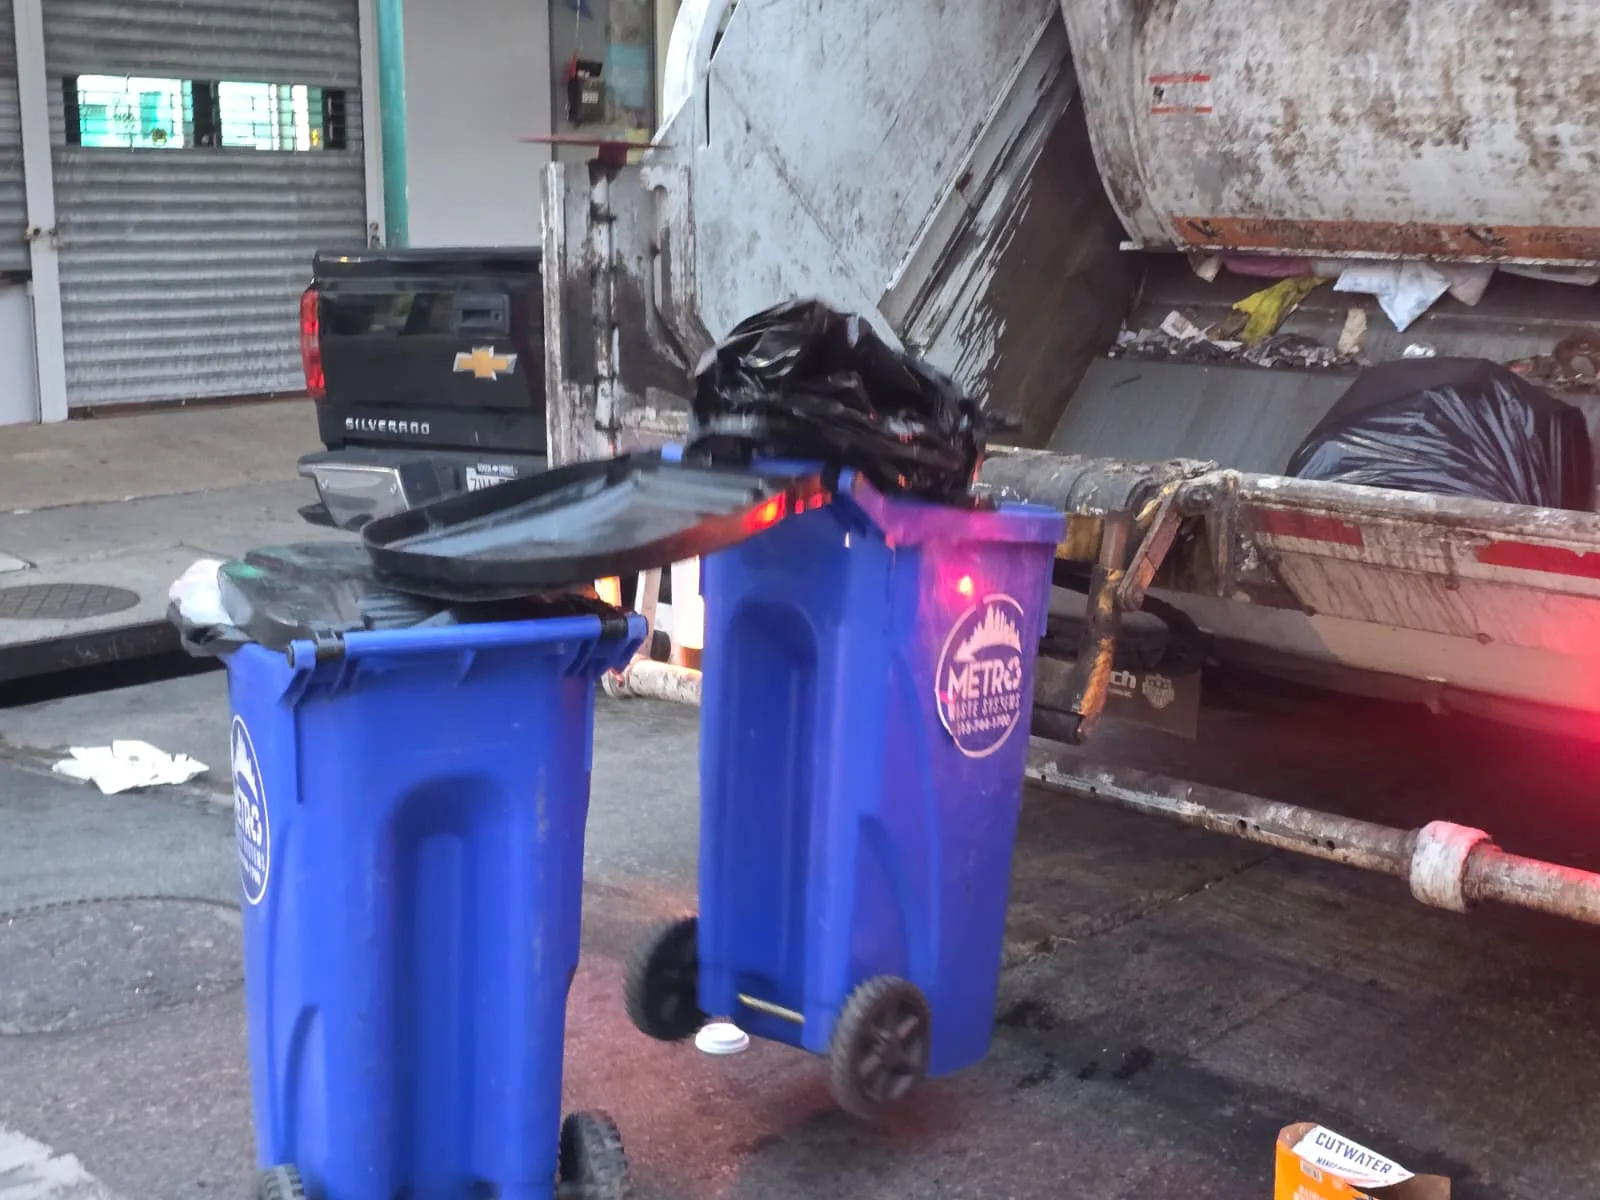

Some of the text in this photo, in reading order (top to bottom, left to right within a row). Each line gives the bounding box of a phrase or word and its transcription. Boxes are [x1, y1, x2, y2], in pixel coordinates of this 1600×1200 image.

[345, 417, 430, 435] SILVERADO
[947, 655, 1023, 701] METRO
[1314, 1131, 1393, 1175] CUTWATER
